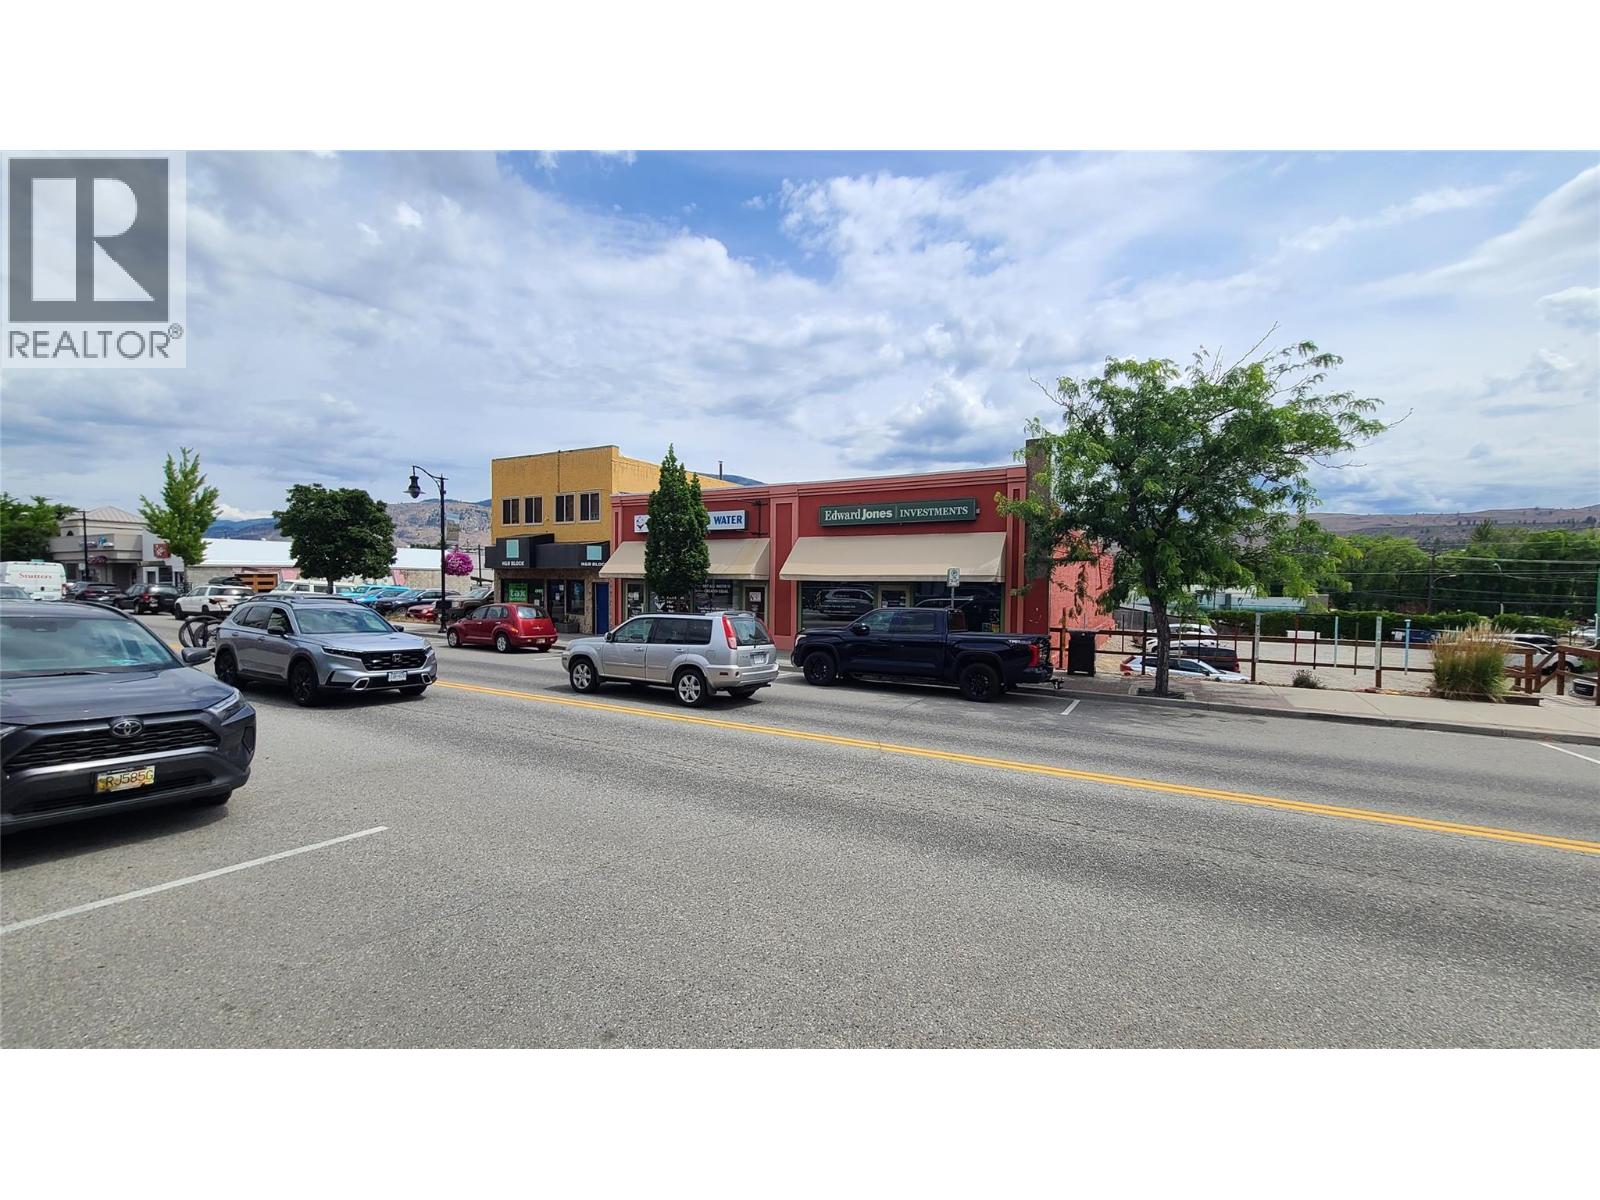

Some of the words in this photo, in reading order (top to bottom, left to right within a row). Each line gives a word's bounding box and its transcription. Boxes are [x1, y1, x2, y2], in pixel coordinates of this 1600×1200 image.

[900, 505, 969, 518] INVESTMENTS
[713, 515, 743, 525] WATER
[510, 589, 526, 598] tax
